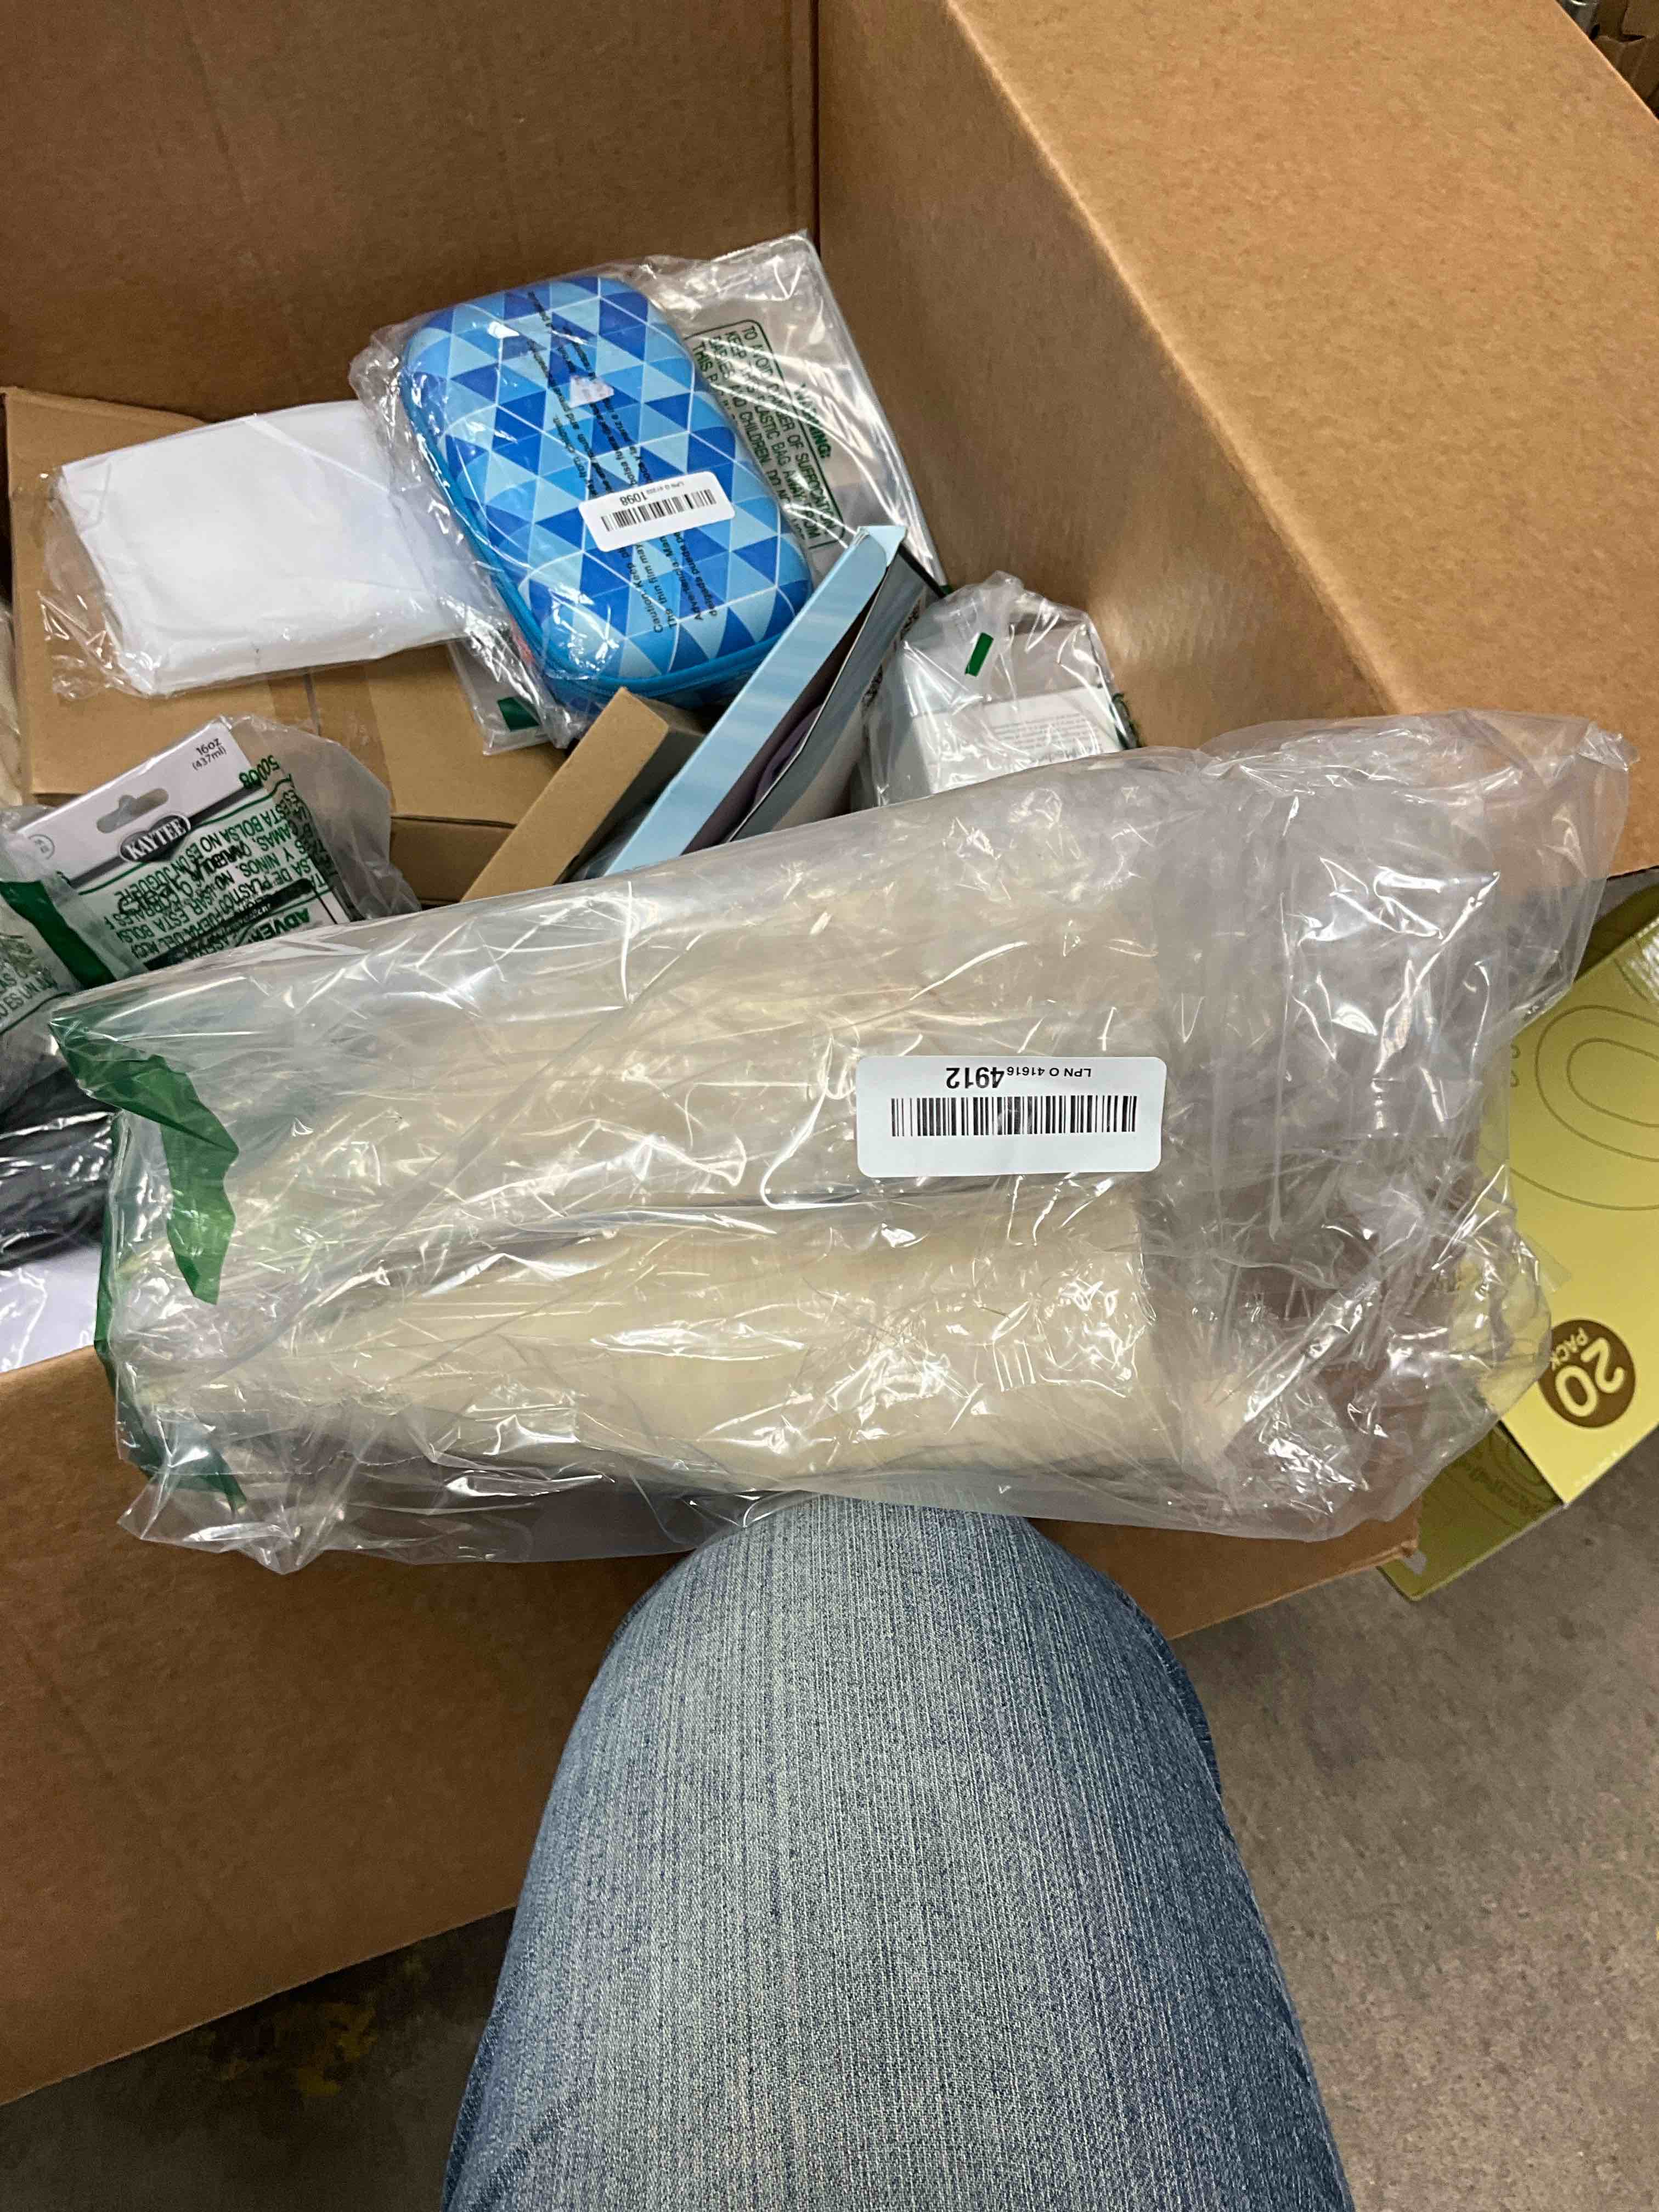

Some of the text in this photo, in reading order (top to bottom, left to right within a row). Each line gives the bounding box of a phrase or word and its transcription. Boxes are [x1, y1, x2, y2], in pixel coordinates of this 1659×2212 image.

[741, 325, 758, 342] TO
[786, 433, 804, 452] OF
[771, 441, 792, 467] BAG
[619, 490, 647, 506] 1098
[642, 564, 658, 585] film
[651, 584, 667, 605] thin
[190, 744, 228, 771] (437ml)
[195, 736, 222, 757] 16oz
[125, 819, 187, 861] KAYTEE
[218, 812, 263, 848] BOLSA
[198, 831, 221, 854] NO
[280, 844, 294, 861] Y
[213, 870, 235, 890] NO
[271, 866, 291, 886] DE
[154, 905, 189, 934] ESTA
[946, 1066, 1005, 1089] 4912
[1064, 1067, 1091, 1077] LPN
[1549, 1325, 1591, 1371] PACK
[1555, 1336, 1624, 1417] 20
